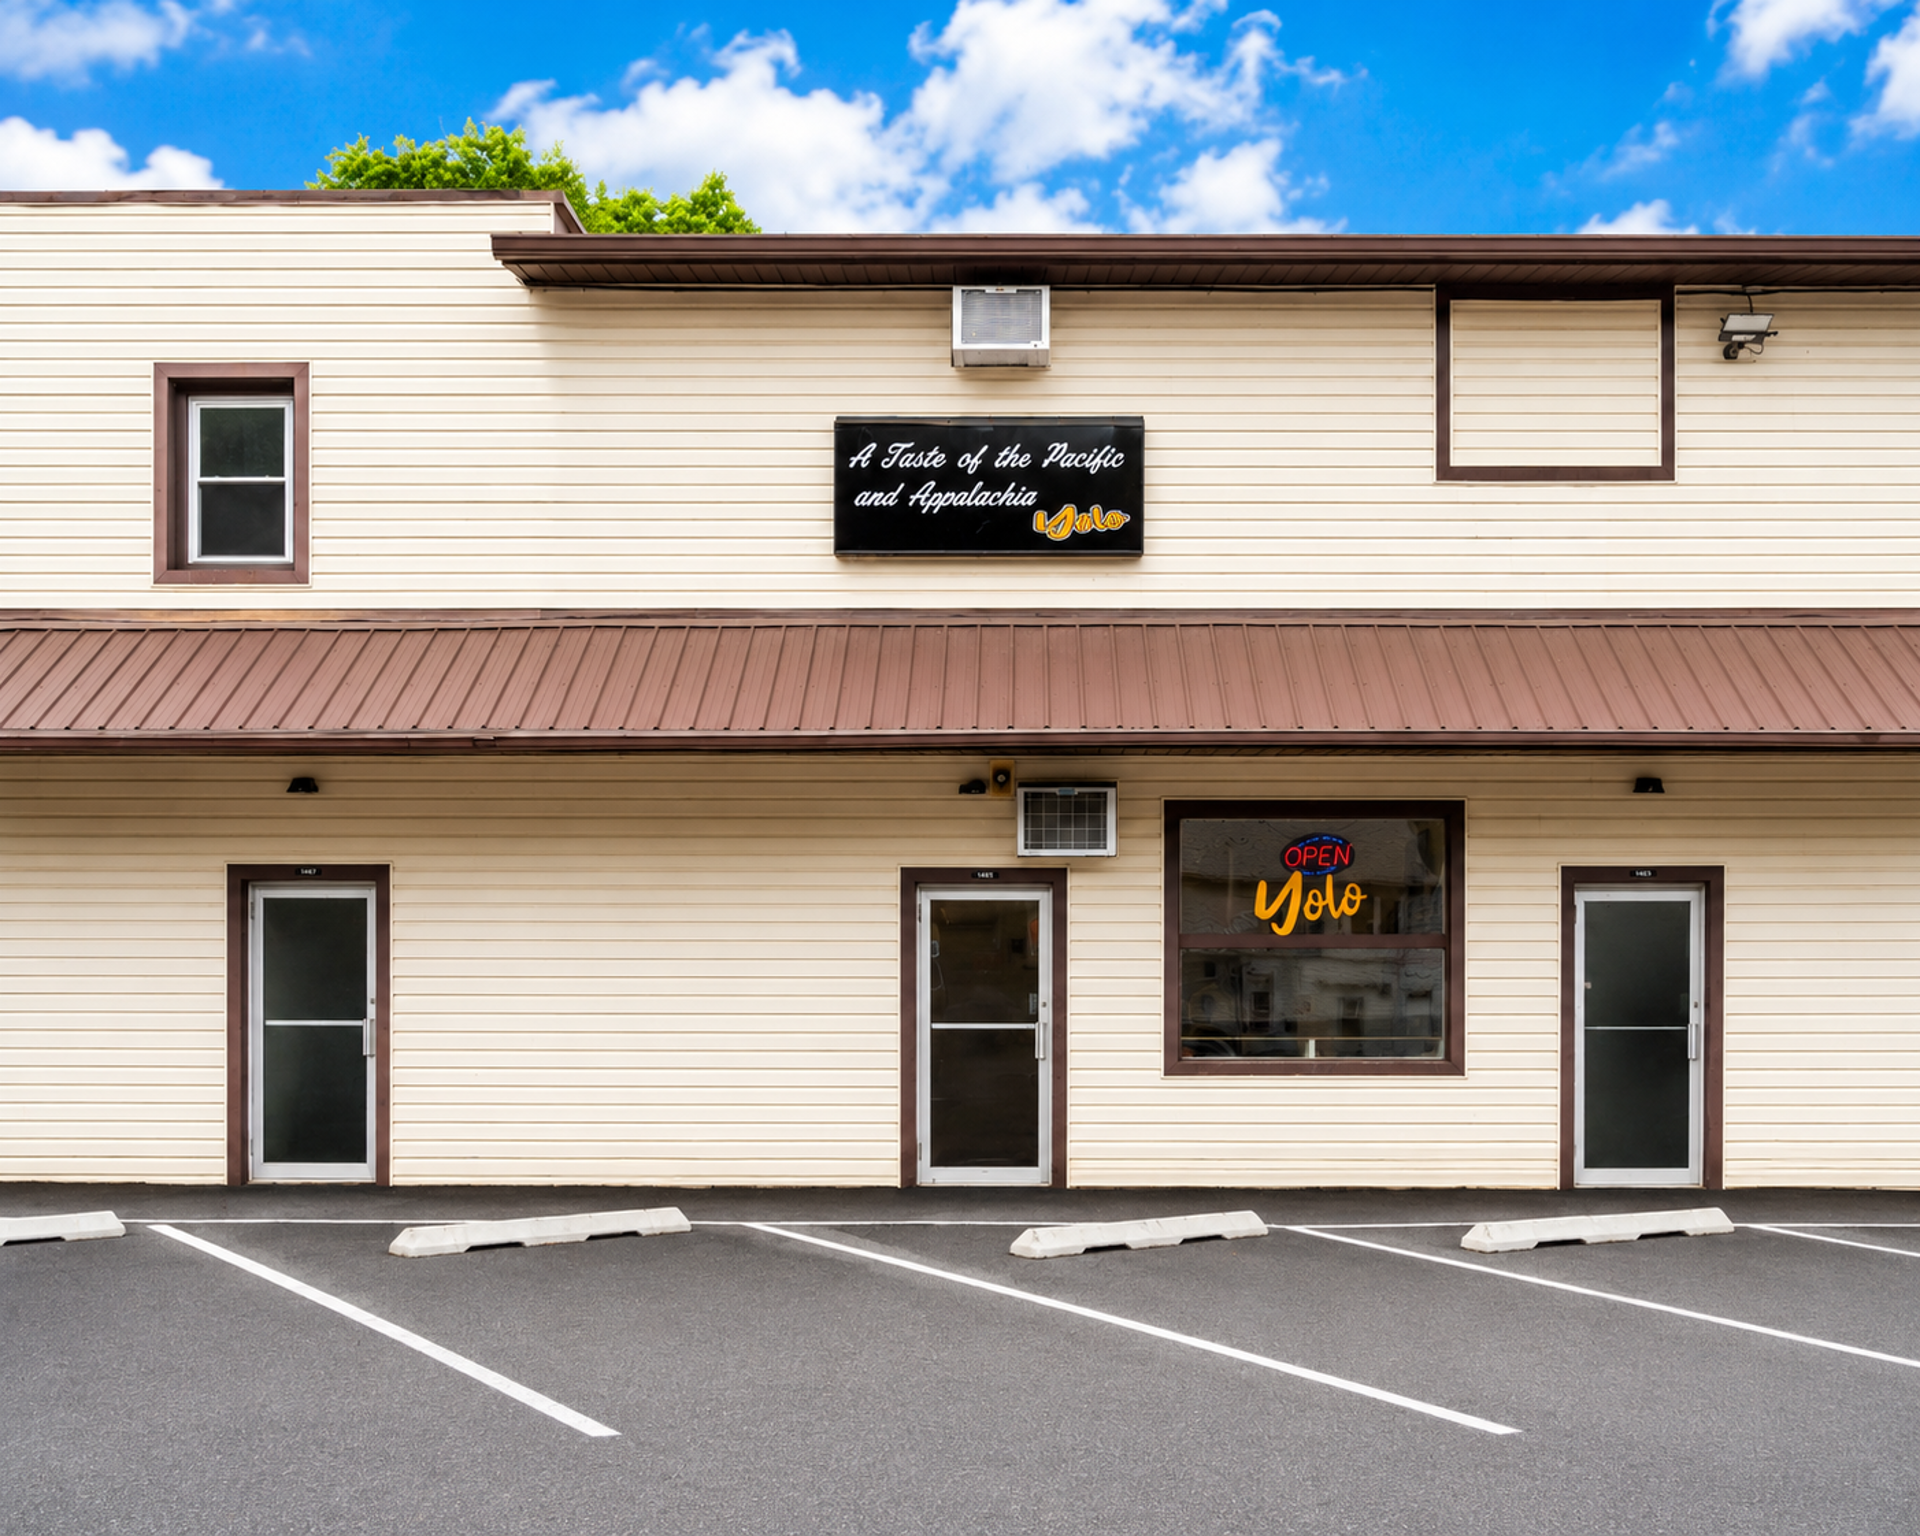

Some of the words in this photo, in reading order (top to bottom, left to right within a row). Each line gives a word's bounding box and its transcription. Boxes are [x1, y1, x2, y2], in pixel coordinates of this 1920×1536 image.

[849, 442, 877, 468] A
[881, 442, 947, 468] Taste
[957, 444, 988, 474] of
[994, 443, 1032, 468] the
[1042, 442, 1124, 474] Pacific
[854, 482, 905, 507] and
[908, 480, 1038, 514] Appalachia
[1284, 843, 1352, 867] OPEN
